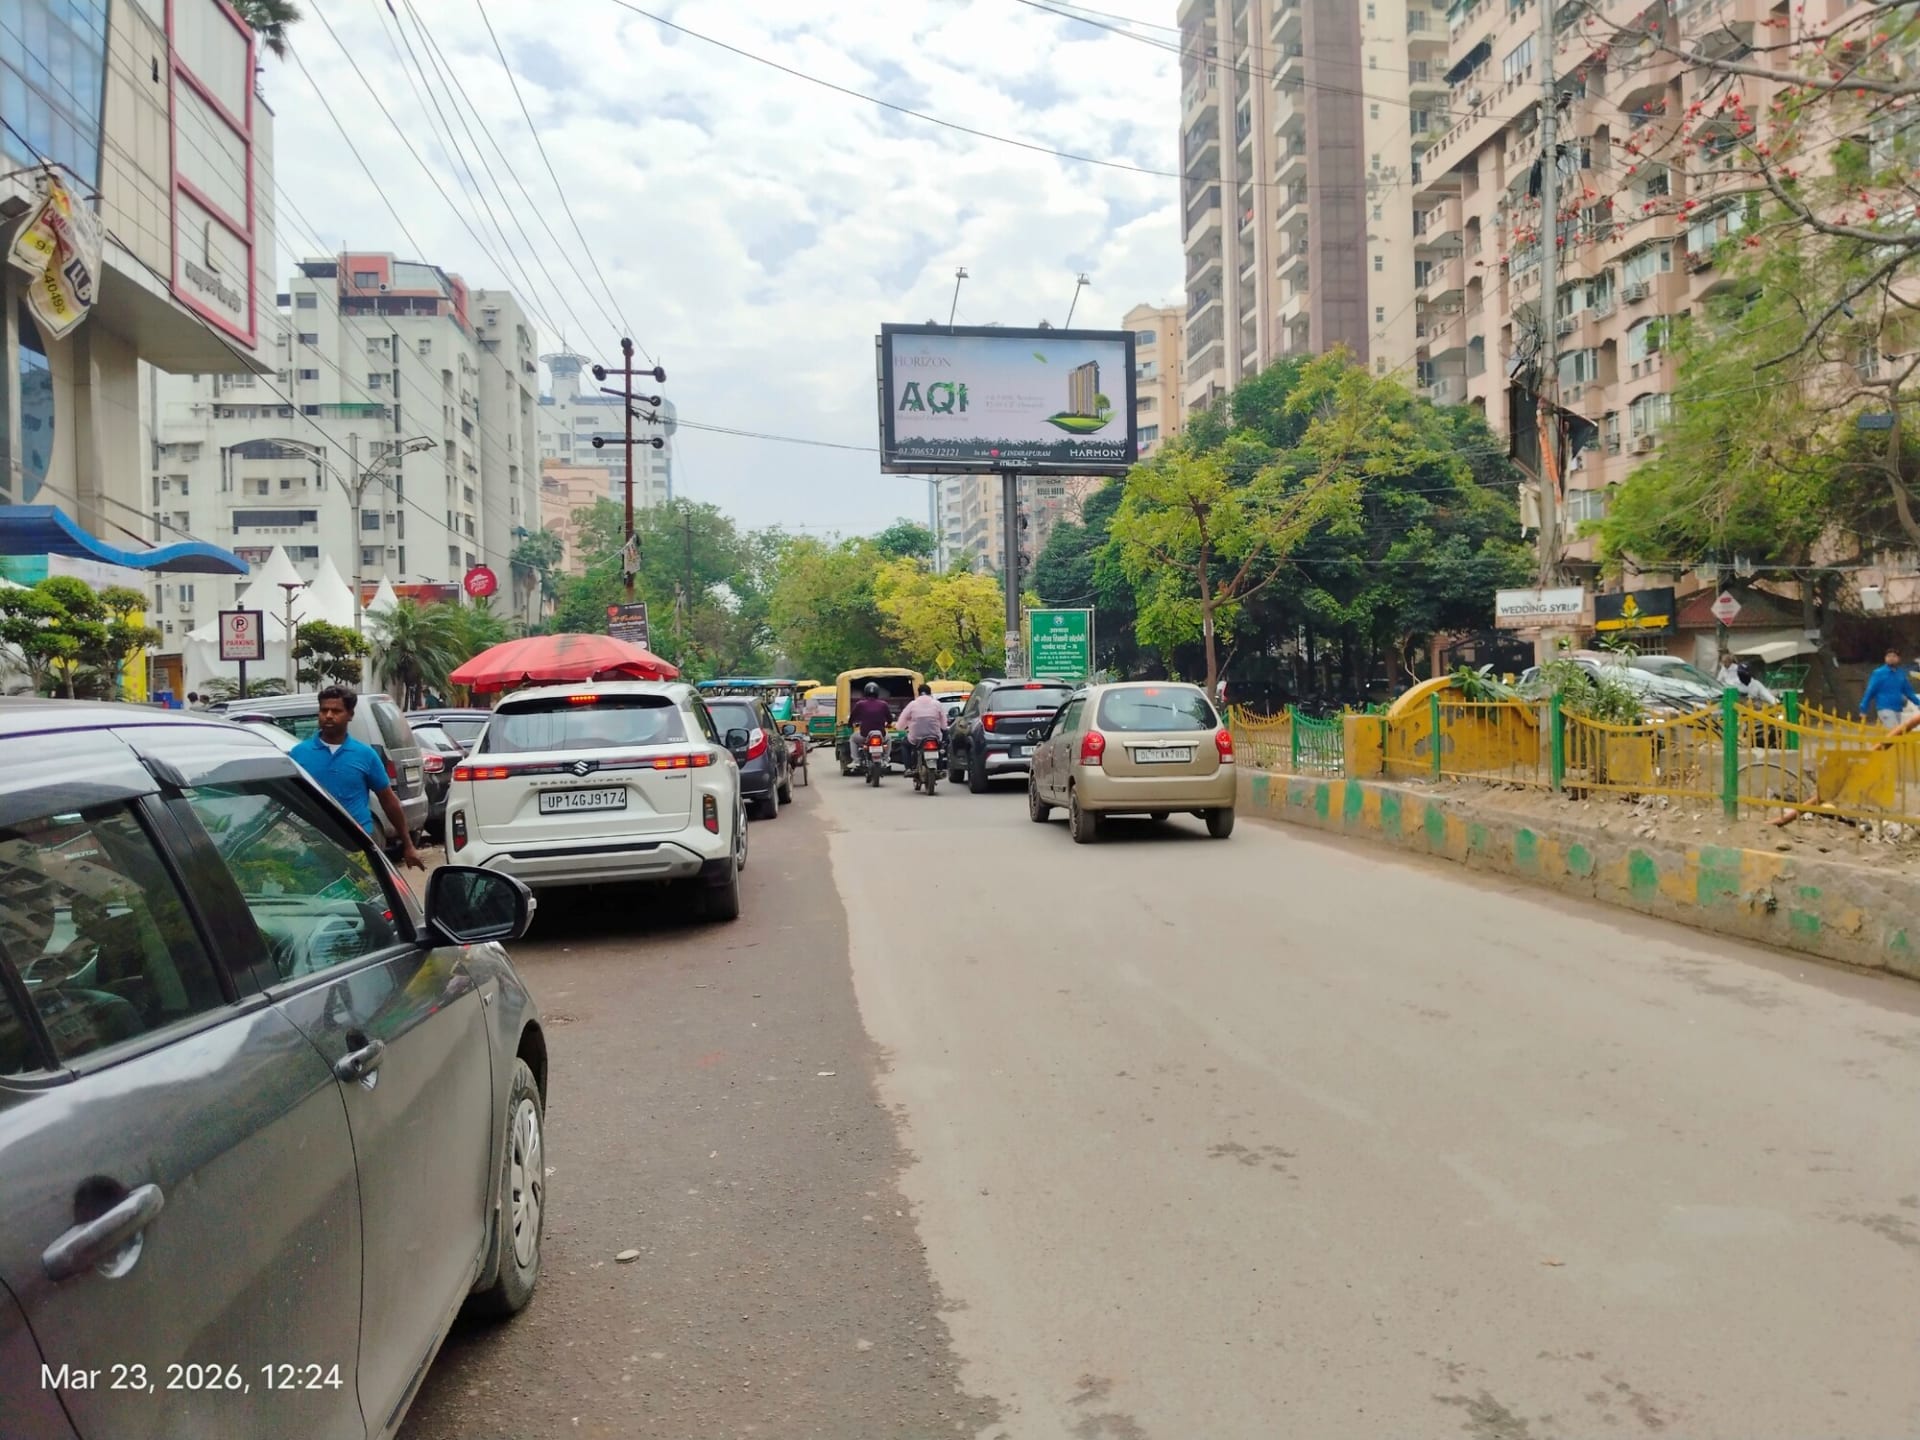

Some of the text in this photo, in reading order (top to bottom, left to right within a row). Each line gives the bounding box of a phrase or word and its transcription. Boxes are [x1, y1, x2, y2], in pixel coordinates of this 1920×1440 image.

[894, 355, 952, 368] HORIZON
[898, 381, 968, 415] AQI
[1007, 449, 1051, 457] INDIRAPURAM
[1070, 449, 1126, 458] HARMONY
[1501, 602, 1579, 614] WEDDING SYRUP
[547, 791, 625, 809] UP14GJ9174
